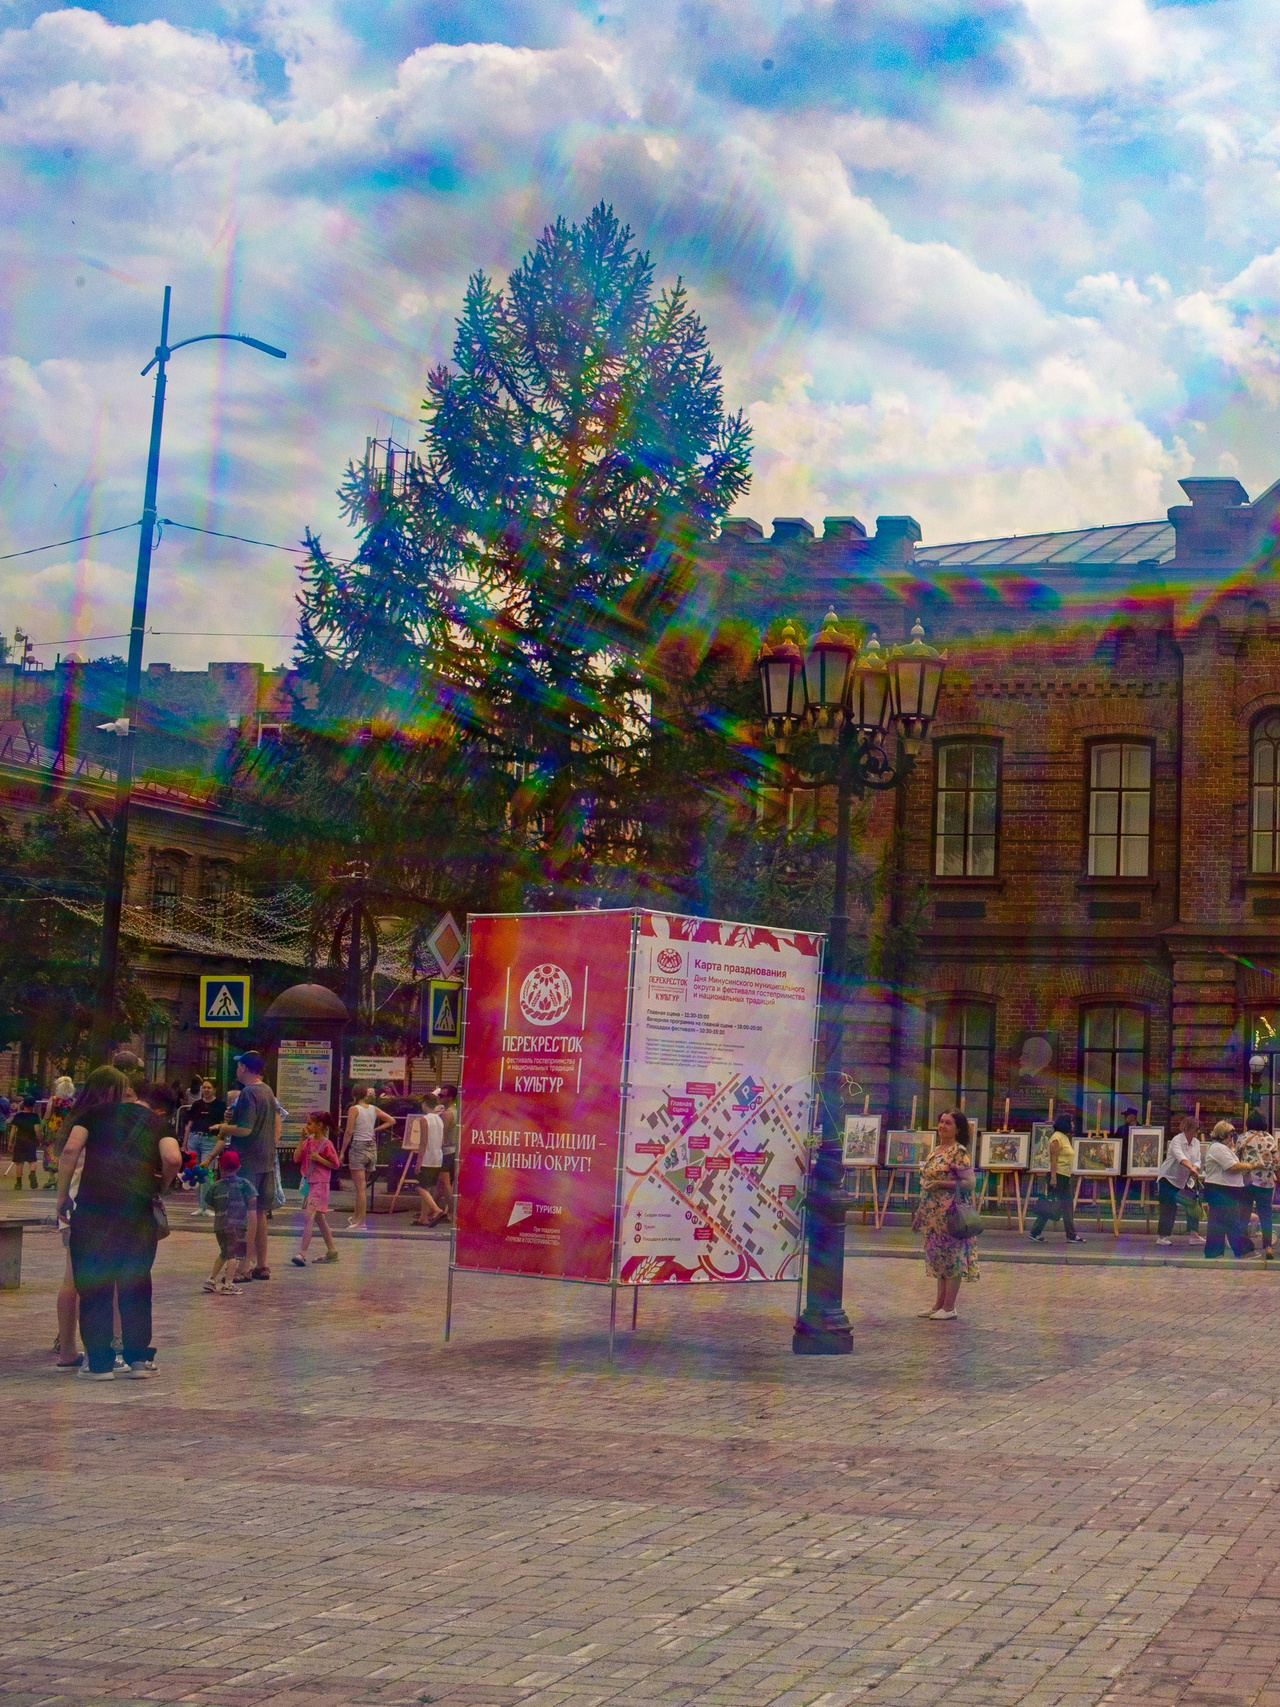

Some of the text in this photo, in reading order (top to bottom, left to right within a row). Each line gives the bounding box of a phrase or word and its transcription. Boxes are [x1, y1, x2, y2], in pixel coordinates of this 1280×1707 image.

[694, 959, 787, 978] Карта празднования
[649, 976, 688, 986] ПЕРЕКРЕСТОК
[708, 976, 753, 987] Минусинского
[754, 983, 805, 992] муниципального
[694, 984, 716, 992] округа
[722, 986, 755, 995] фестиваля
[756, 991, 806, 1000] гостеприимства
[698, 993, 745, 1002] национальных
[746, 997, 776, 1006] традиций
[502, 1035, 583, 1053] ПЕРЕКРЕСТОК
[515, 1076, 564, 1093] КУЛЬТУР
[471, 1129, 521, 1146] РАЗНЫЕ
[524, 1132, 596, 1151] ТРАДИЦИИ
[485, 1151, 591, 1172] ЕДИНЫЙ ОКРУГ!
[536, 1205, 562, 1214] ТУРИЗМ
